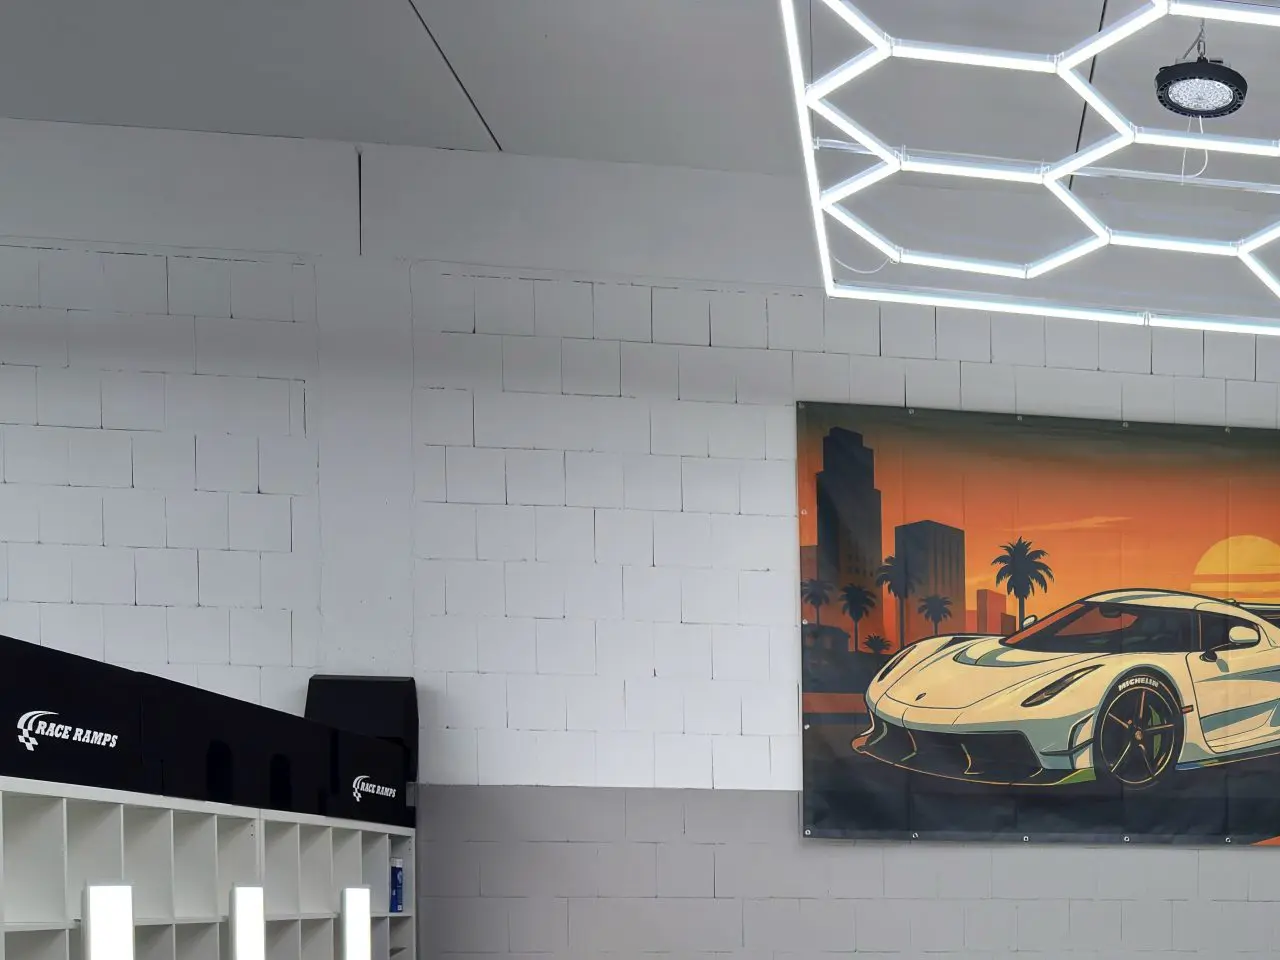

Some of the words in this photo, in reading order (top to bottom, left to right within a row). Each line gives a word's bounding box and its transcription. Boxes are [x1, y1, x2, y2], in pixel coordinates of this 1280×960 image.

[1118, 677, 1159, 691] MICHELIN
[35, 720, 72, 740] RACE
[72, 727, 119, 748] RAMPS
[360, 781, 376, 795] RACE
[376, 785, 397, 799] RAMPS
